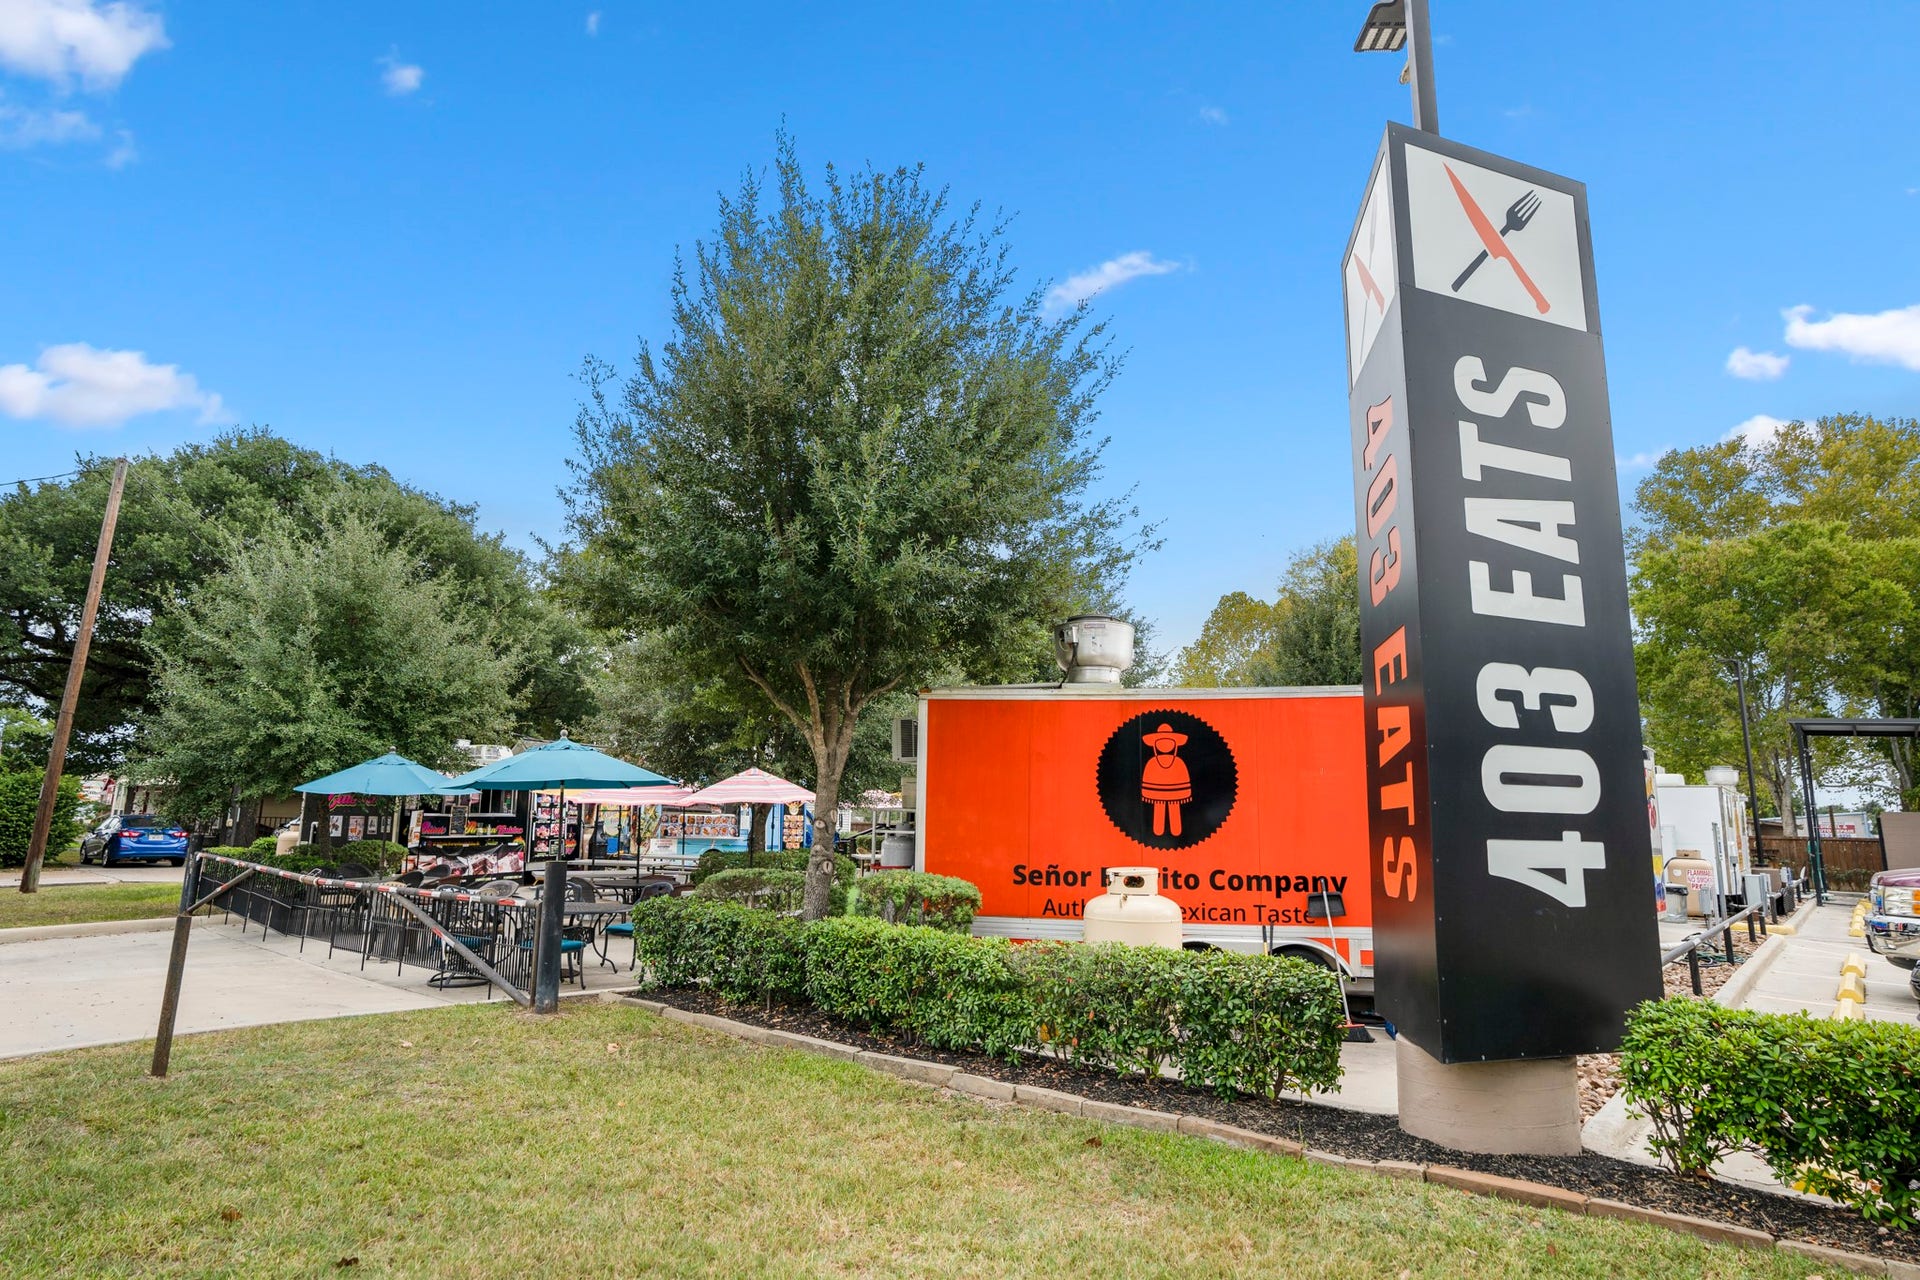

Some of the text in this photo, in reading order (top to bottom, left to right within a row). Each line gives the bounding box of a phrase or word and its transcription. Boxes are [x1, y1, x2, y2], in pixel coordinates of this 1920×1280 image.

[1363, 394, 1418, 902] 403 EATS
[1453, 355, 1606, 908] 403 EATS
[1013, 864, 1092, 887] Señor
[1209, 869, 1348, 898] Company
[1181, 903, 1247, 921] exican
